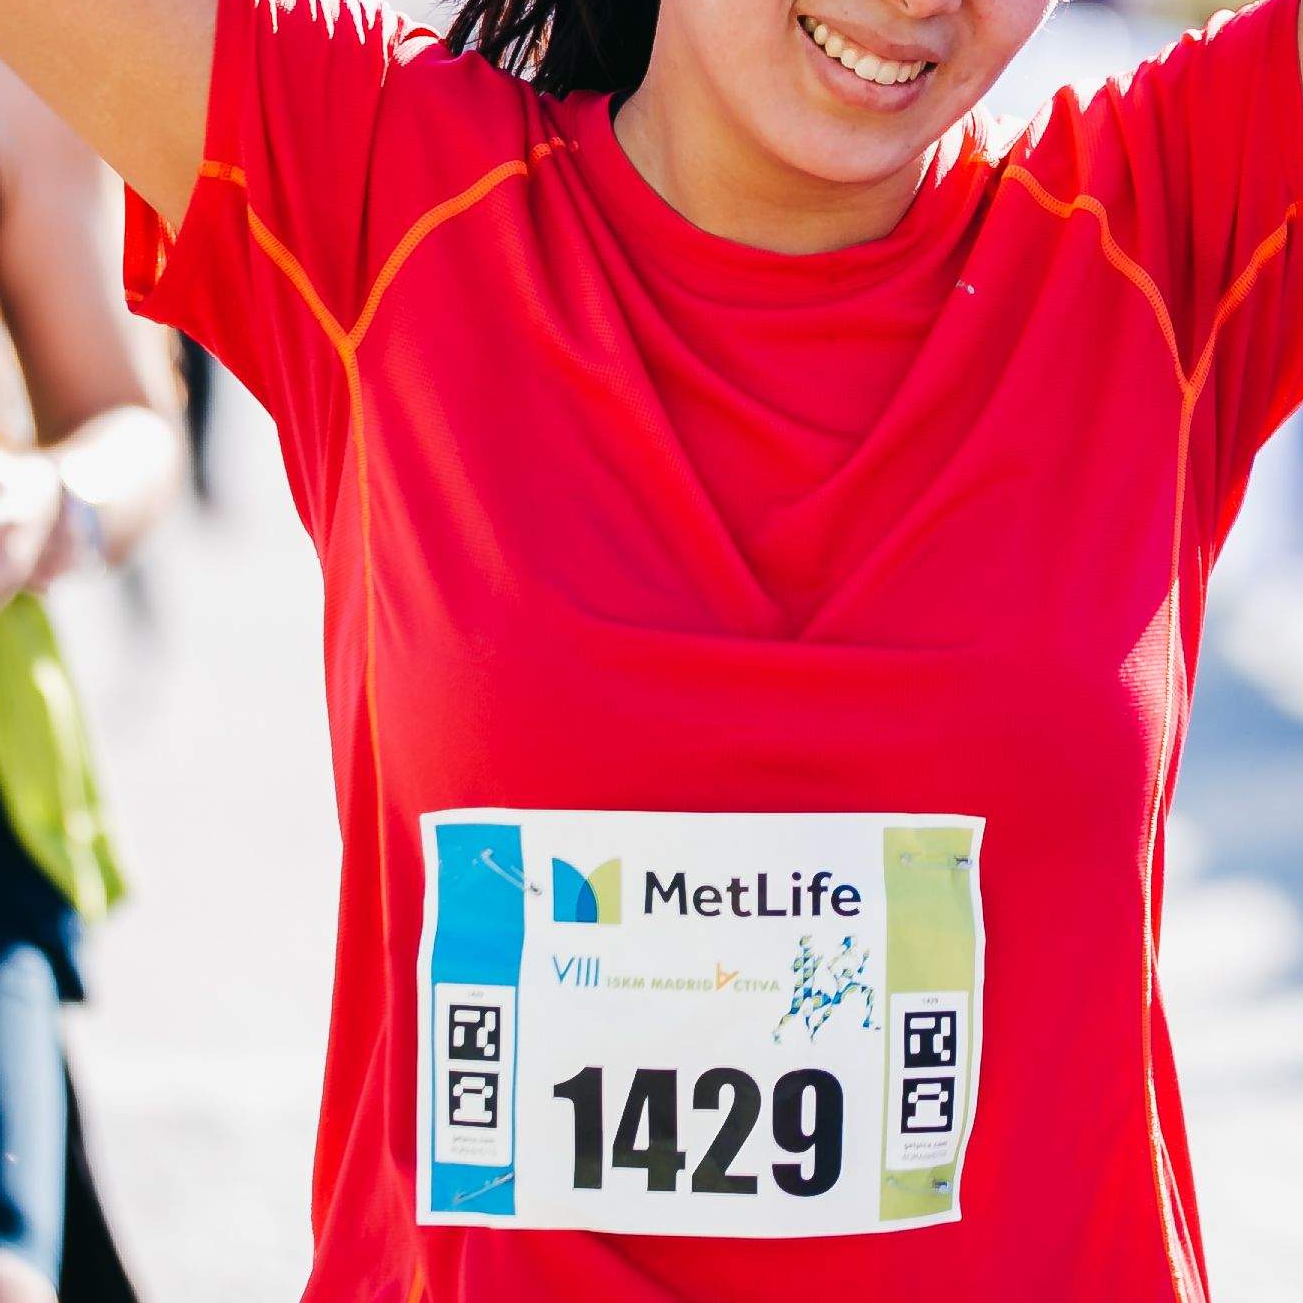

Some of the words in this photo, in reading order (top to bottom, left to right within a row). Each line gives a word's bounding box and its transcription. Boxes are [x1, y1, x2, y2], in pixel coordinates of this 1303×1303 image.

[644, 871, 862, 917] MetLife
[552, 955, 600, 987] VIII
[553, 1066, 844, 1198] 1429
